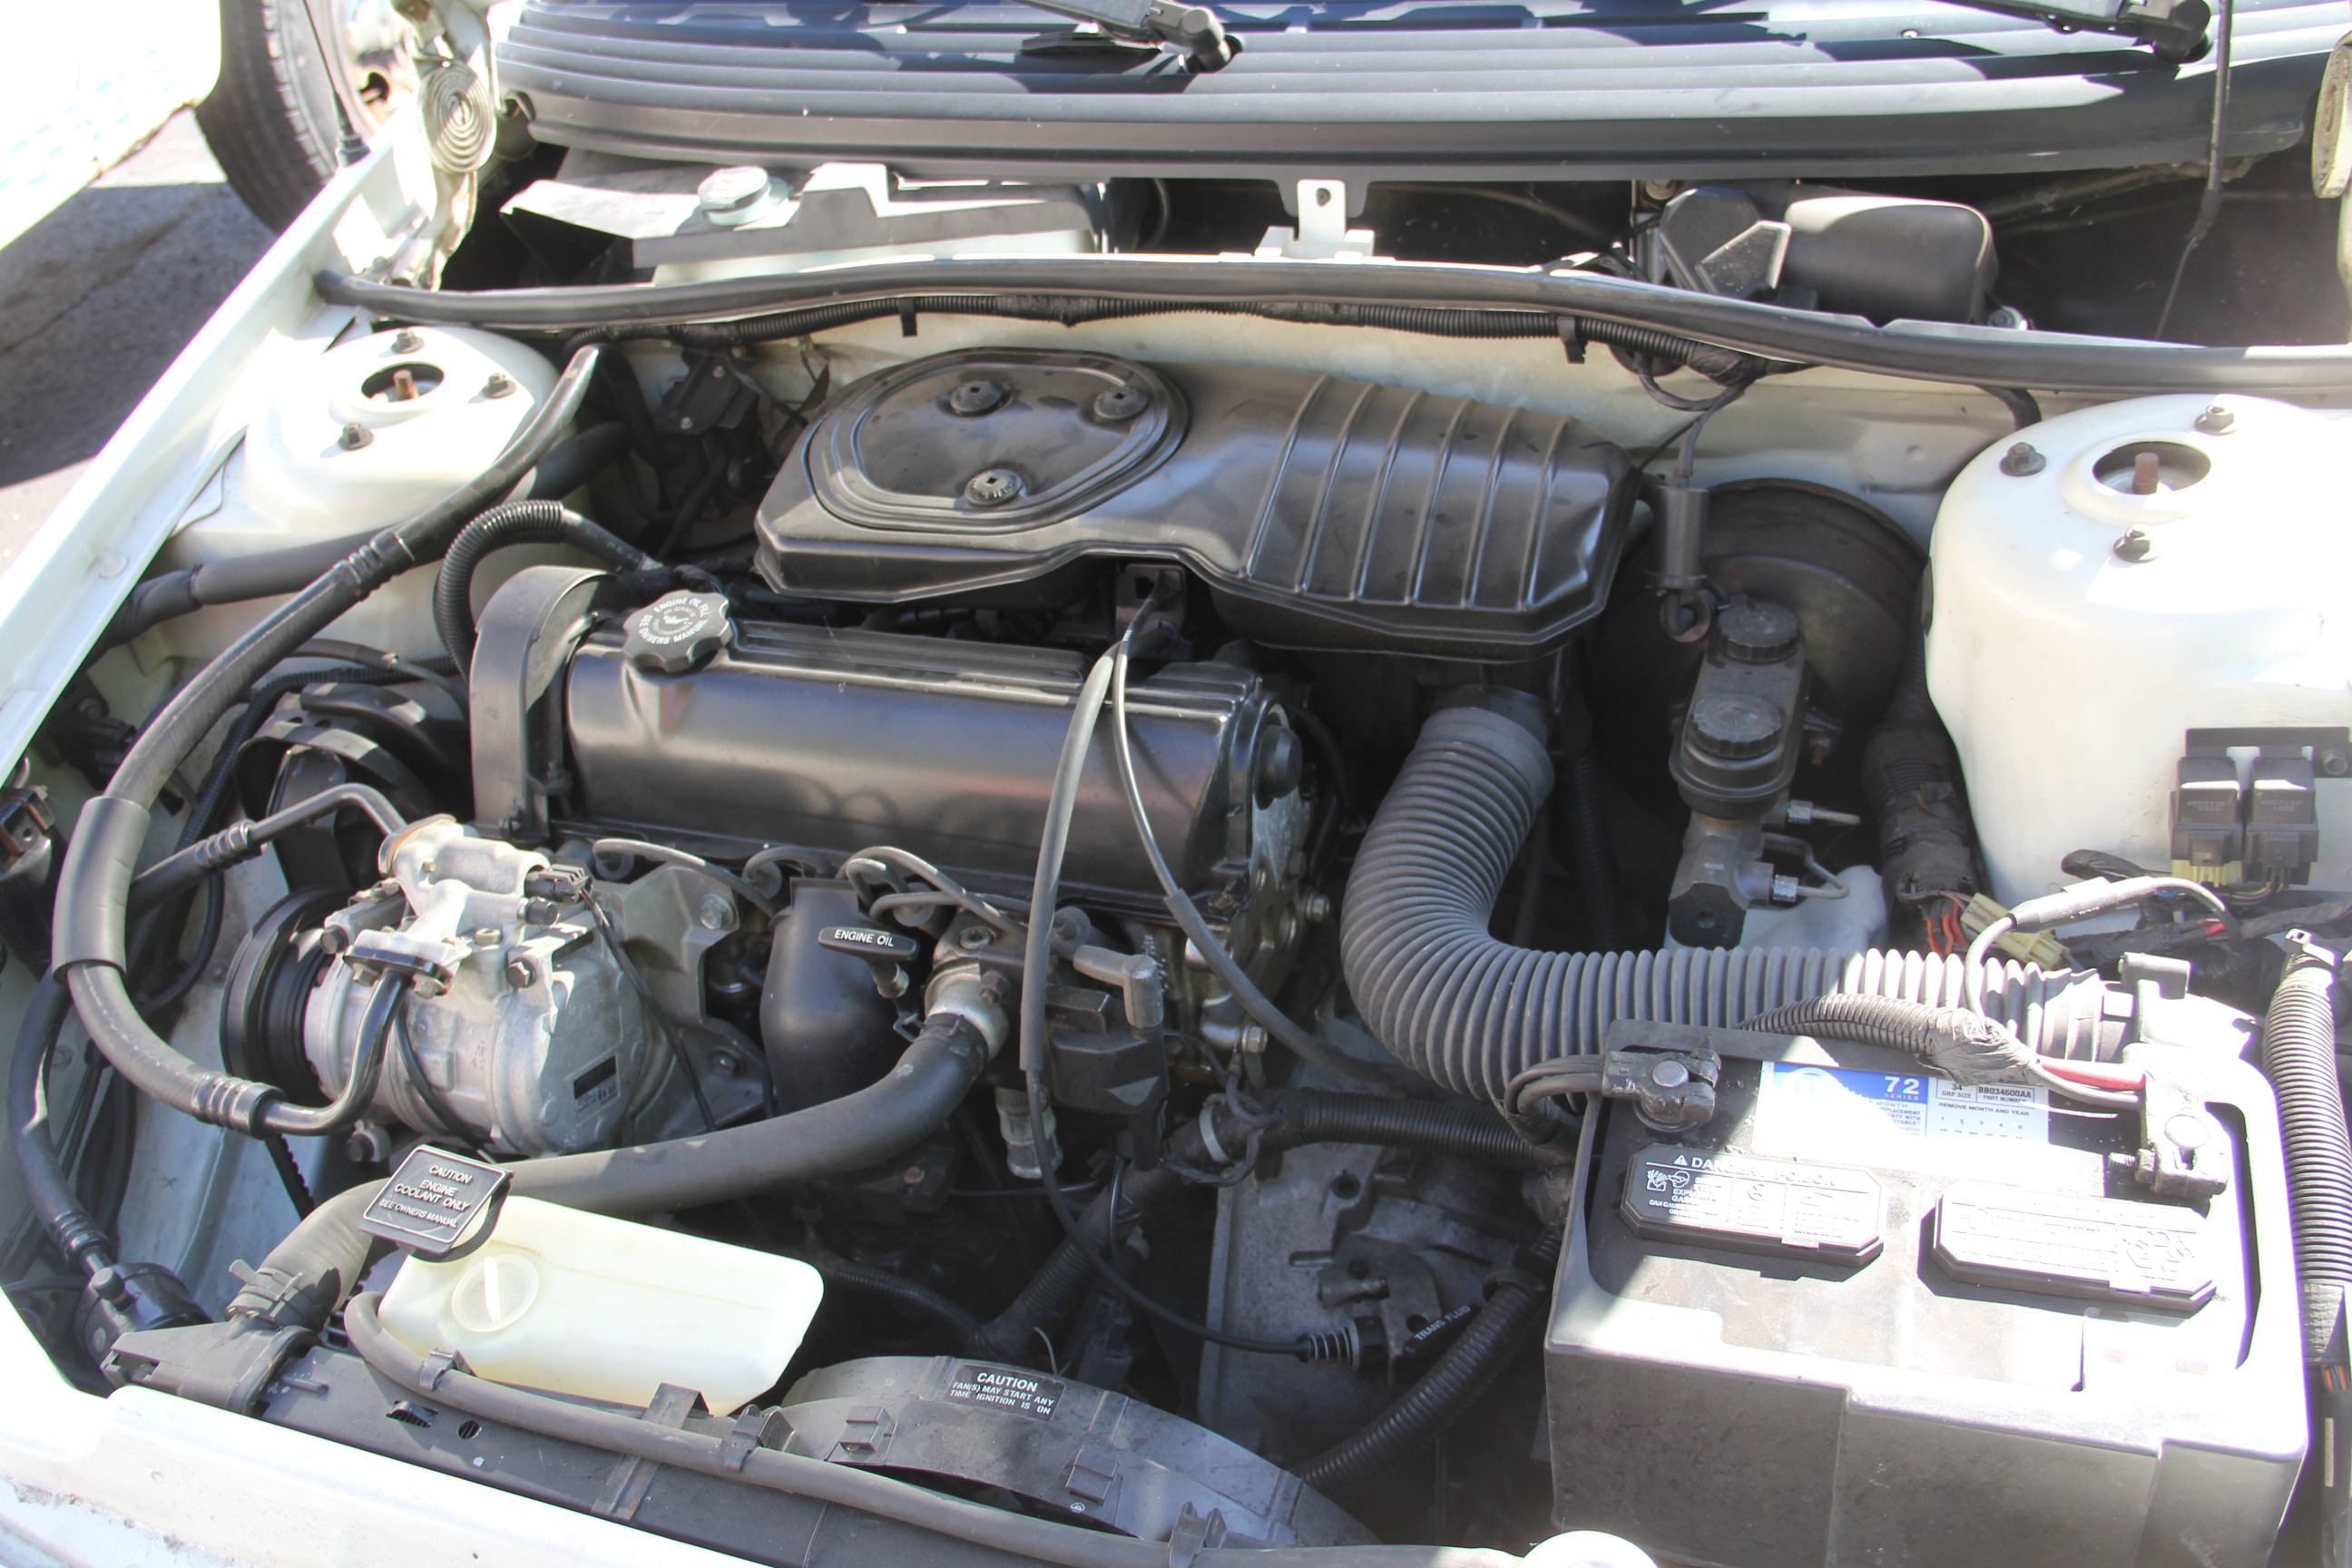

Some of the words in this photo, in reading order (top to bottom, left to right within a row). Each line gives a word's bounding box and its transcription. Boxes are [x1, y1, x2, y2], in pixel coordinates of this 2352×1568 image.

[653, 597, 689, 612] ENGINE
[689, 598, 702, 608] OIL
[639, 614, 653, 627] SEE
[639, 629, 671, 645] OWNERS
[673, 620, 709, 643] MANUAL
[834, 929, 874, 943] ENGINE
[877, 936, 894, 947] OIL
[1884, 1076, 1920, 1095] 72
[1951, 1083, 1963, 1092] 34
[1876, 1101, 1907, 1109] MONTH
[1938, 1102, 1967, 1110] REMOVE
[428, 1164, 474, 1184] CAUTION
[394, 1182, 443, 1204] COOLANT
[443, 1198, 471, 1212] ONLY
[419, 1180, 458, 1196] ENGINE
[379, 1198, 396, 1209] SEE
[396, 1203, 427, 1219] OWNERS
[426, 1212, 458, 1229] MANUAL
[1414, 1319, 1446, 1341] TRANS
[1444, 1306, 1471, 1322] FLUID
[976, 1372, 1039, 1392] CAUTION
[950, 1389, 971, 1399] TIME
[975, 1394, 1016, 1406] IGNITION
[1021, 1401, 1031, 1410] IS
[1036, 1406, 1052, 1416] ON
[952, 1381, 981, 1393] FAN(S)
[982, 1386, 1002, 1395] MAY
[1003, 1388, 1033, 1401] START
[1034, 1396, 1055, 1406] ANY
